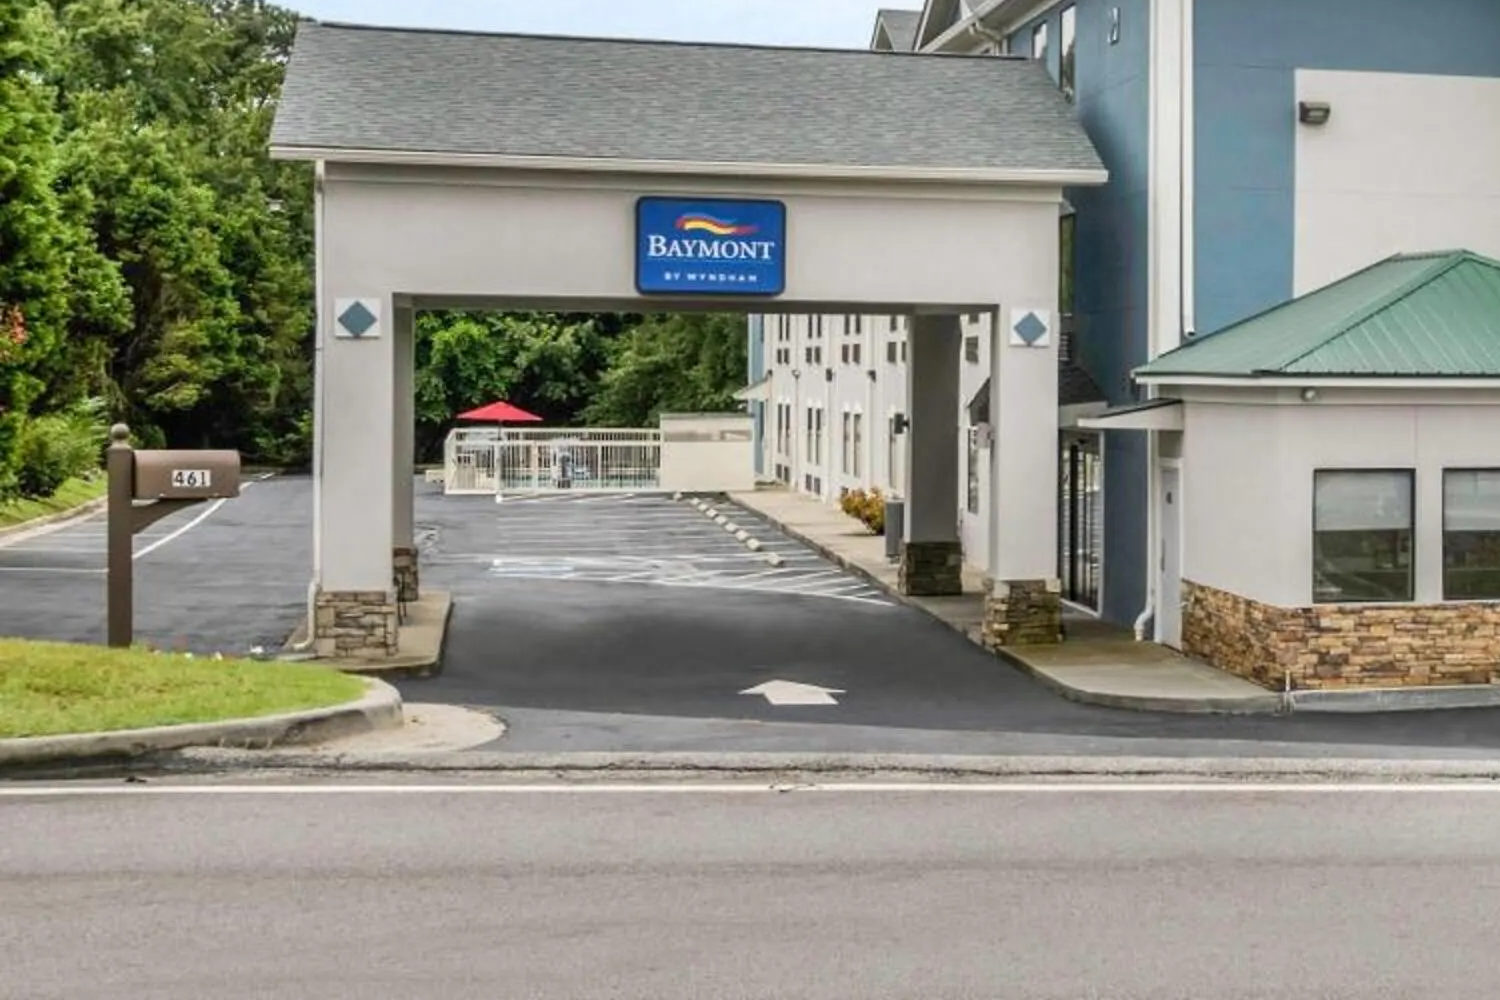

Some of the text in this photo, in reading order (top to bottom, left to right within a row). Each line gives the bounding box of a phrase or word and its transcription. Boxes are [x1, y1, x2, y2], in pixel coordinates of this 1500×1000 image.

[647, 234, 775, 261] BAYMONT
[663, 272, 758, 282] BY WYNDHAM
[173, 471, 207, 486] 461
